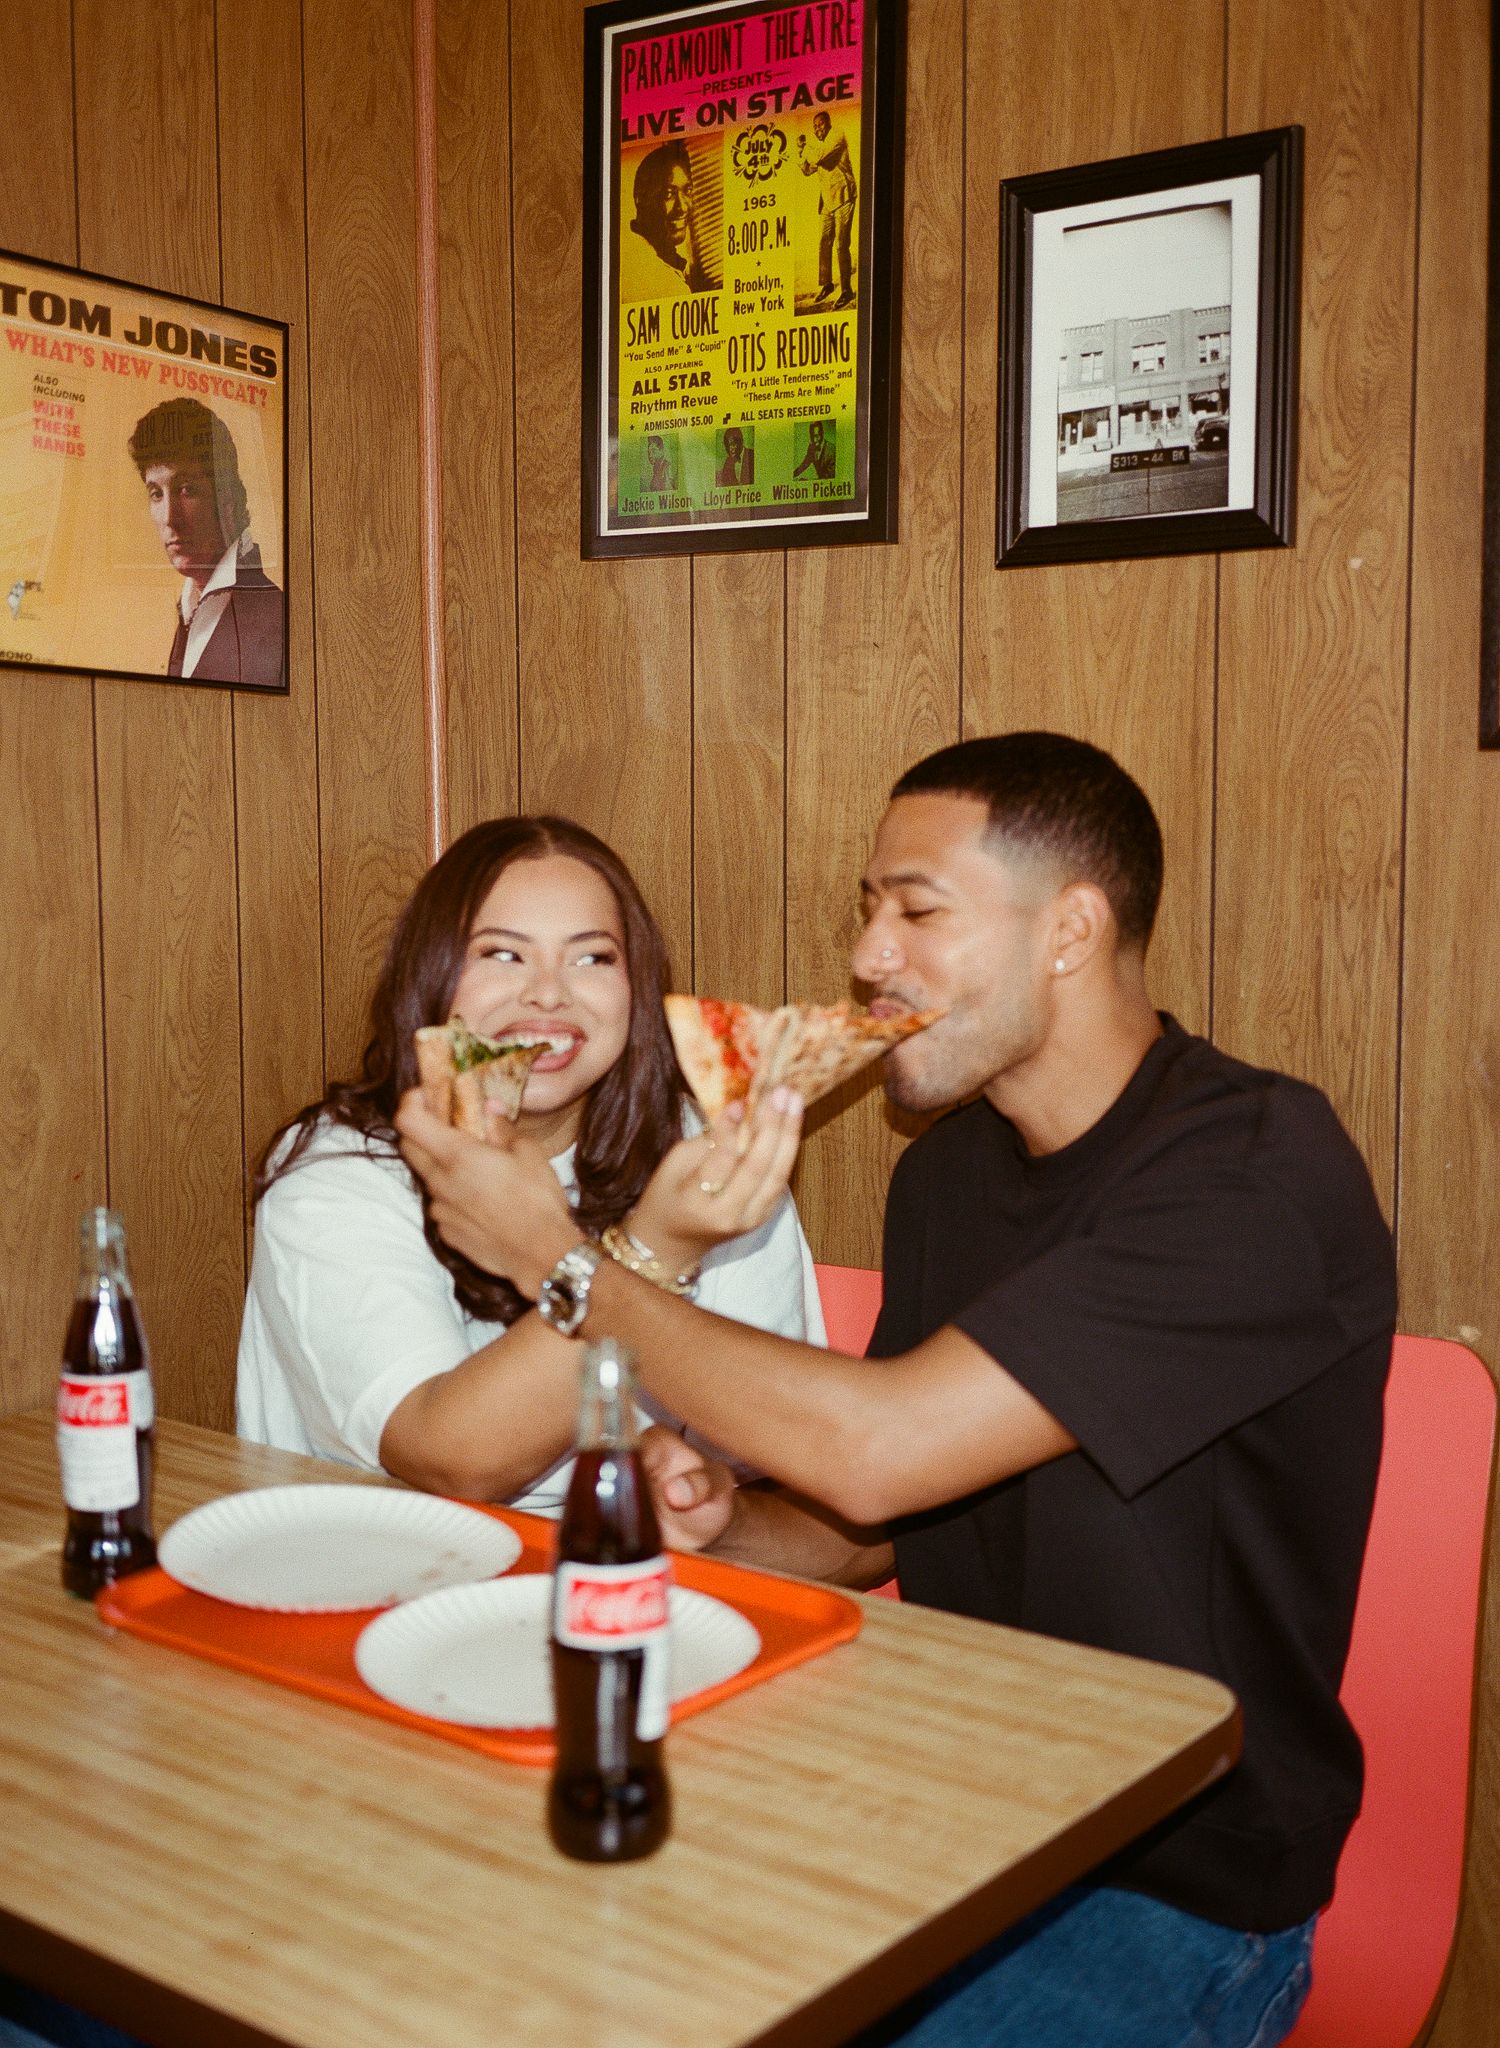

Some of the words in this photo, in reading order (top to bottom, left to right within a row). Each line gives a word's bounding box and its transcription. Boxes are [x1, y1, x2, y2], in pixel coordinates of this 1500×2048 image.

[624, 22, 746, 94] PARAMOUNT
[762, 1, 858, 64] THEATRE
[703, 70, 772, 96] PRESENTS
[622, 107, 685, 141] LIVE
[696, 98, 737, 128] ON
[747, 73, 855, 119] STAGE
[745, 139, 773, 154] JULY
[748, 154, 769, 168] 4th
[743, 194, 776, 211] 1963
[734, 277, 784, 294] Brooklyn,
[733, 300, 755, 316] New
[760, 296, 785, 312] York
[0, 282, 111, 338] TOM
[124, 315, 277, 379] JONES
[627, 304, 660, 347] SAM
[671, 296, 719, 340] COOKE
[646, 348, 665, 359] Send
[686, 344, 692, 354] &
[728, 332, 766, 374] OTIS
[777, 322, 850, 369] REDDING
[5, 328, 95, 369] WHAT'S
[102, 349, 153, 381] NEW
[159, 364, 268, 407] PUSSYCAT?
[644, 365, 662, 374] ALSO
[665, 360, 703, 371] APPEARING
[33, 374, 59, 386] ALSO
[632, 378, 661, 396] ALL
[668, 371, 712, 391] STAR
[751, 378, 756, 387] A
[760, 376, 779, 387] Little
[837, 368, 852, 379] and
[33, 385, 86, 403] INCLUDING
[774, 389, 795, 399] Arms
[797, 387, 812, 397] Are
[631, 398, 677, 415] Rhythm
[681, 395, 718, 409] Revue
[644, 418, 688, 432] ADMISSION
[691, 415, 713, 427] $5.00
[741, 411, 755, 421] ALL
[758, 408, 784, 420] SEATS
[787, 404, 831, 418] RESERVED
[32, 417, 81, 439] THESE
[32, 435, 86, 458] HANDS
[704, 491, 731, 507] Lloyd
[735, 488, 761, 504] Price
[773, 483, 808, 500] Wilson
[813, 481, 851, 497] Pickett
[622, 498, 654, 513] Jackie
[660, 495, 691, 509] Wilson
